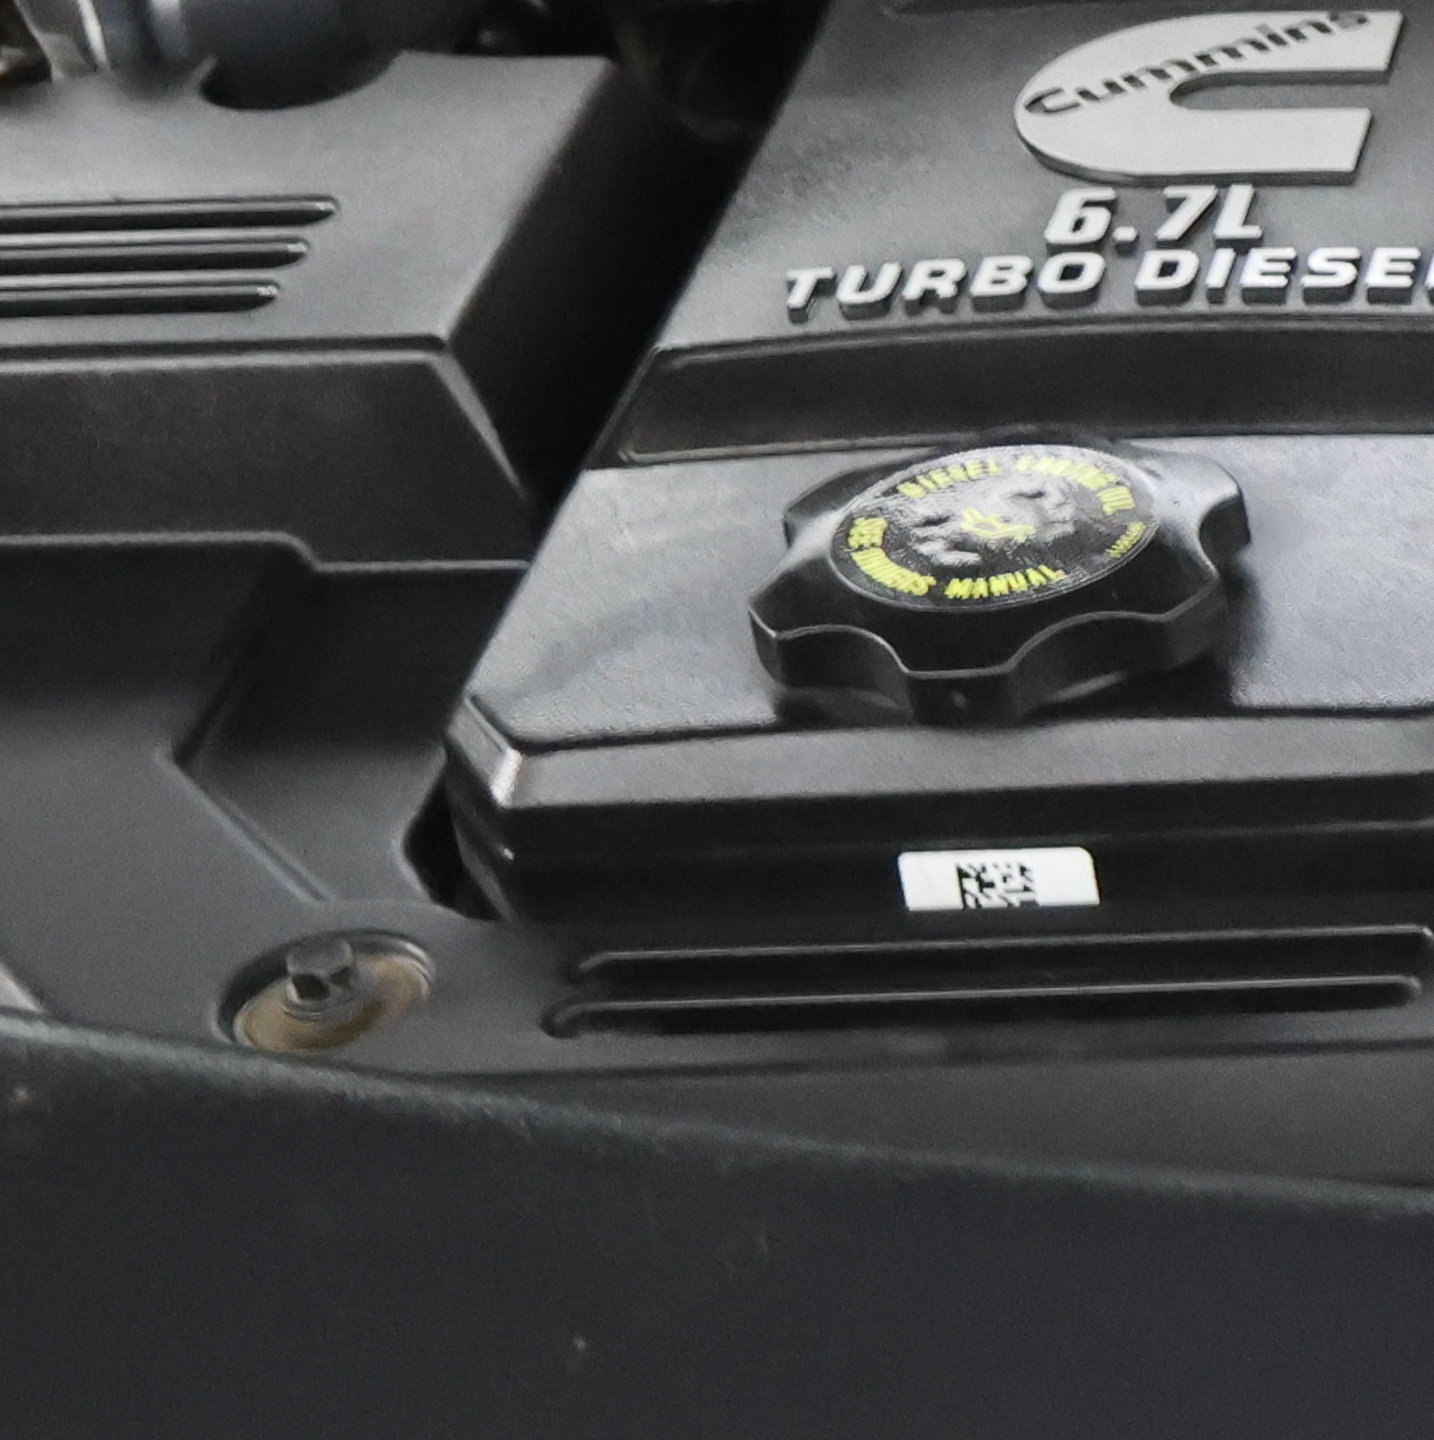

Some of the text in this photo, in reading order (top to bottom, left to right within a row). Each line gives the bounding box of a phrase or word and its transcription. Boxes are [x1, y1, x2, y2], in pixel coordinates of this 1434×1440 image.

[1022, 10, 1371, 116] Cummins
[1044, 183, 1263, 254] 6.7L
[785, 254, 1105, 322] TURBO
[944, 564, 1066, 600] MANUAL
